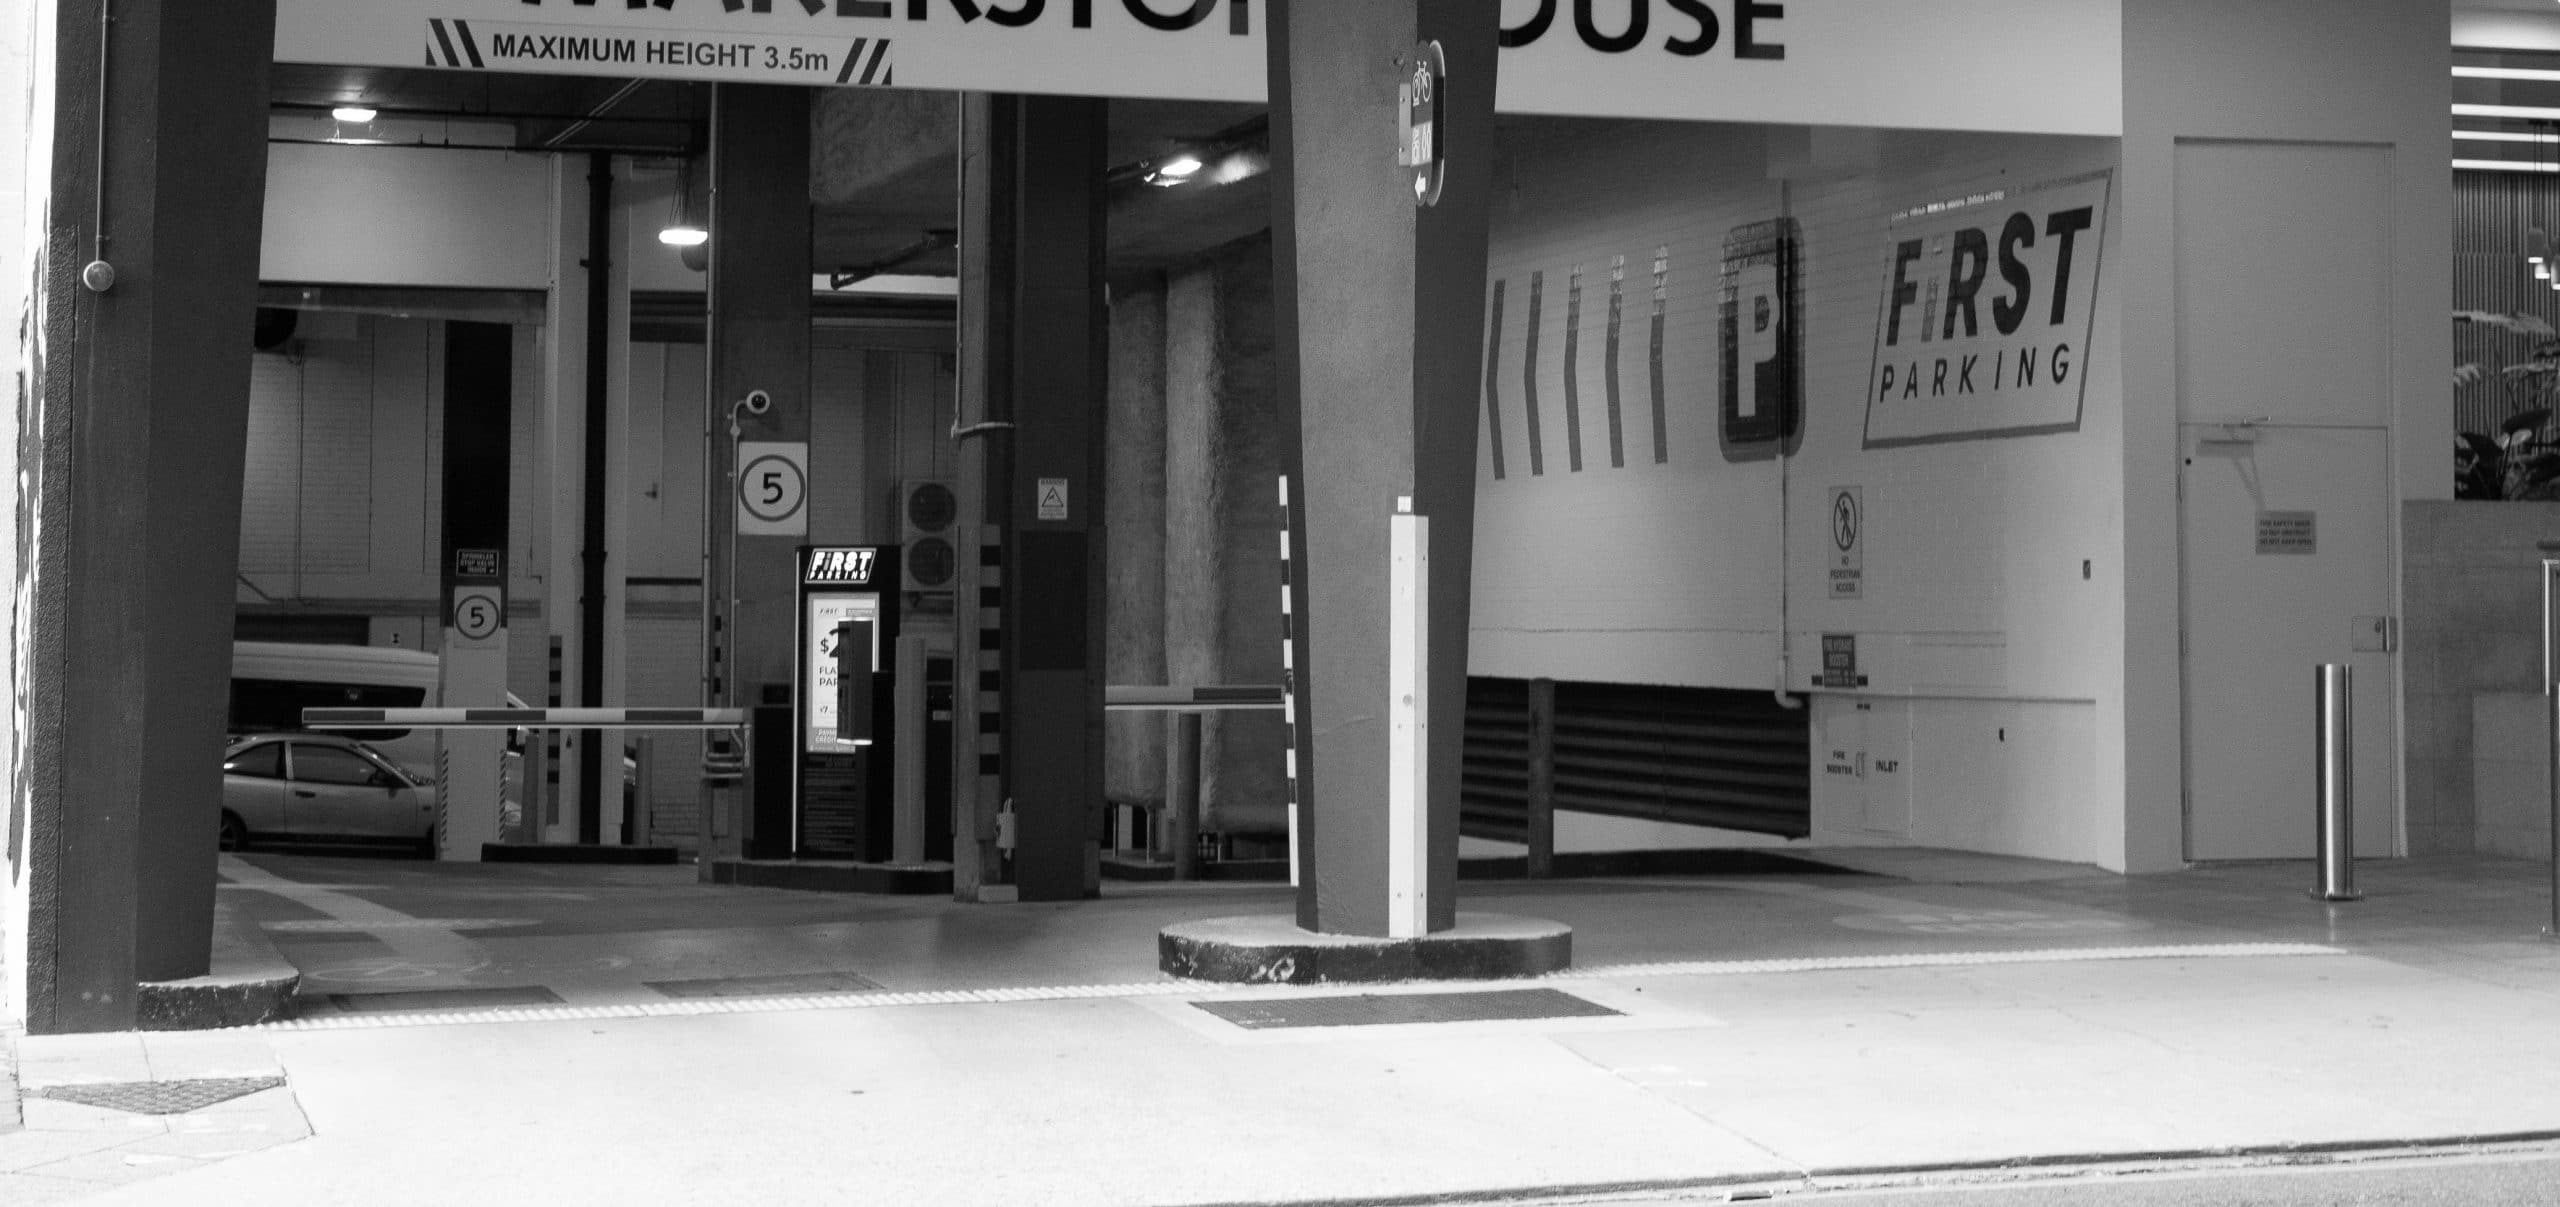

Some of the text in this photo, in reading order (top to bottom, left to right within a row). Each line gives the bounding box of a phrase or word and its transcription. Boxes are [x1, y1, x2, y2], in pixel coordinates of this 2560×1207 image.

[1498, 0, 1786, 60] USE
[492, 33, 829, 71] MAXIMUM HEIGHT 3.5m
[1738, 264, 1781, 417] P
[1880, 343, 2070, 403] PARKING
[762, 472, 783, 504] 5
[809, 570, 867, 580] PARKING
[470, 606, 485, 628] 5
[819, 666, 837, 675] FLA
[1876, 759, 1898, 773] INLET
